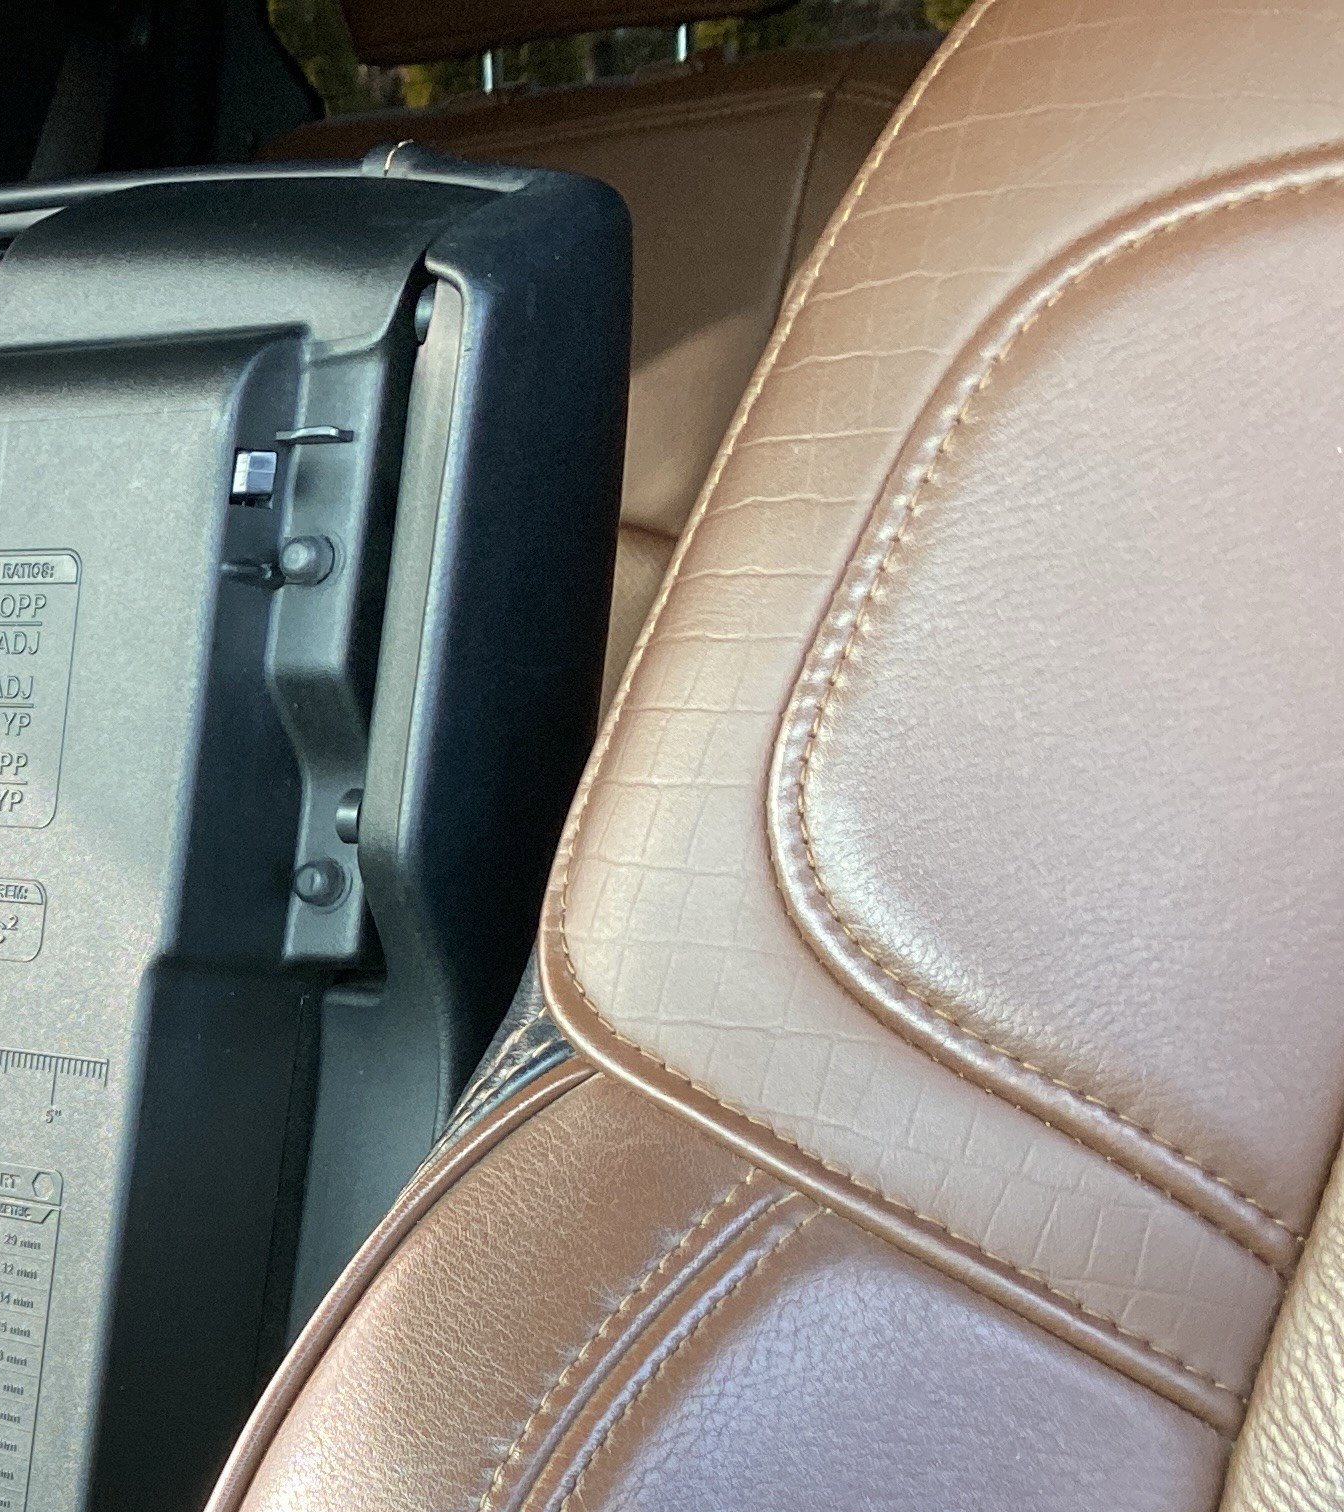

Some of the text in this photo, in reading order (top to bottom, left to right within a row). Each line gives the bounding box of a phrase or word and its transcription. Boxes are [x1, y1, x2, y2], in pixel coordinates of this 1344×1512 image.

[1, 562, 55, 580] RATIOS:
[0, 593, 47, 619] OPP
[19, 1237, 41, 1251] mm
[15, 1267, 37, 1280] mm
[12, 1296, 34, 1309] mm
[9, 1325, 31, 1338] mm
[6, 1353, 27, 1367] mm
[2, 1381, 24, 1396] mm
[0, 1410, 21, 1424] mm
